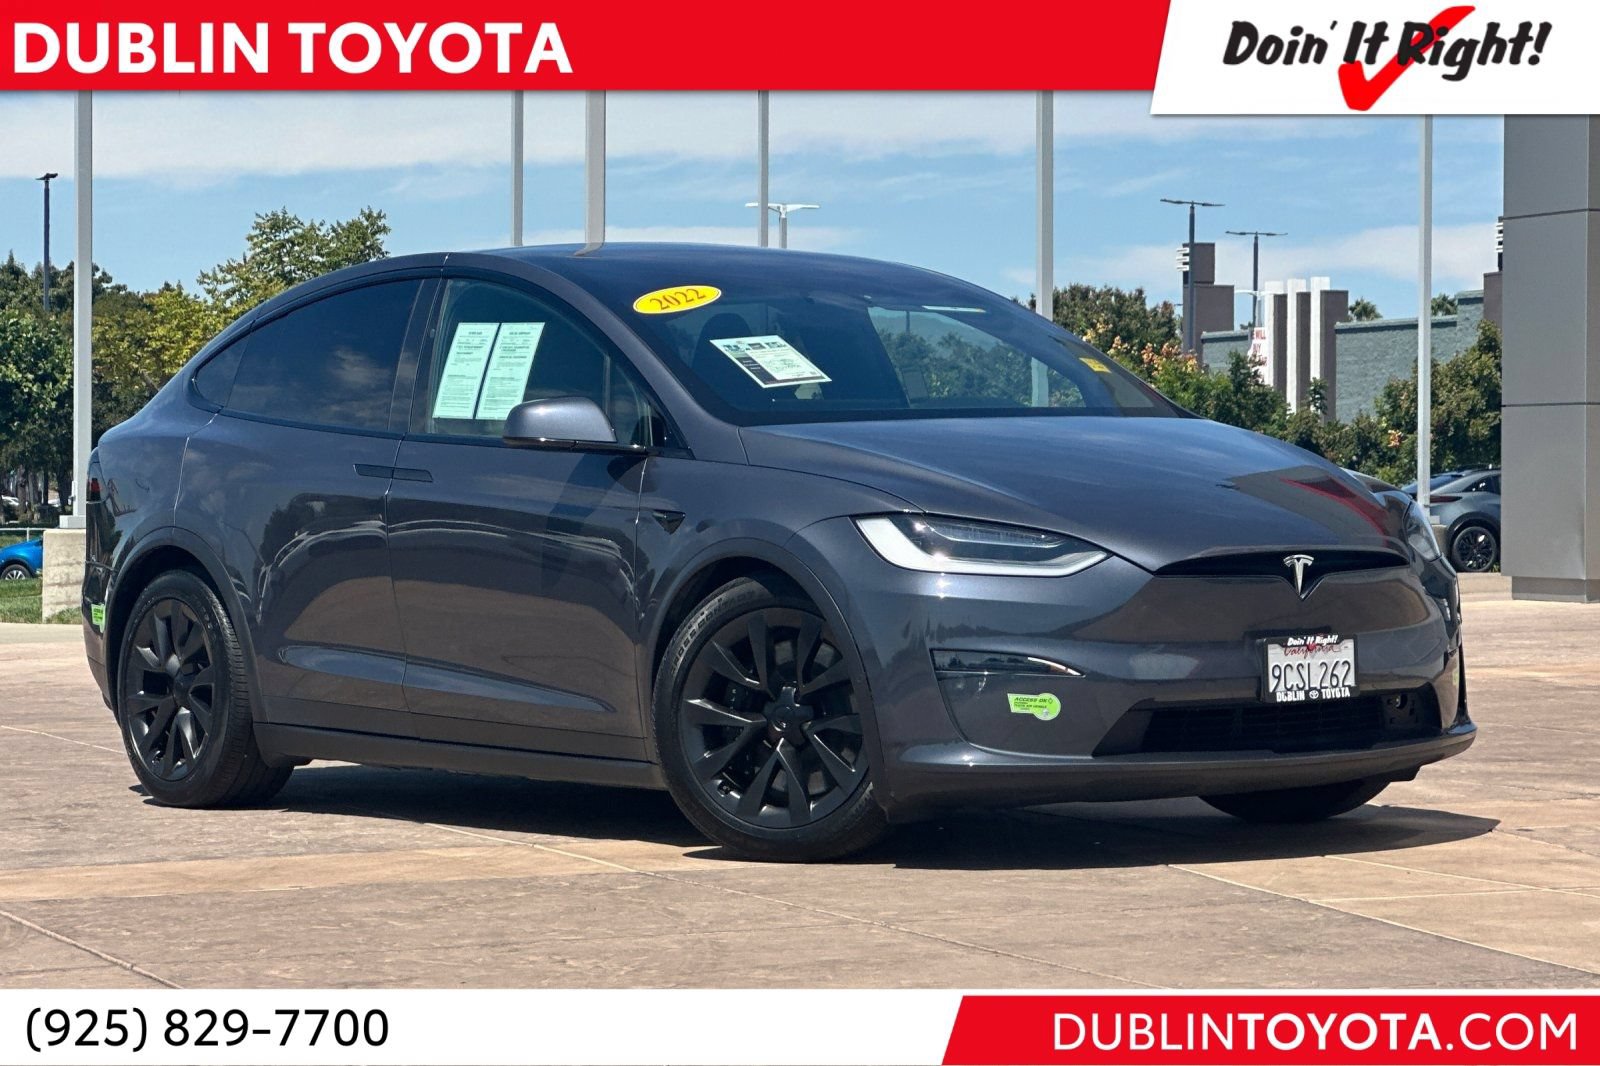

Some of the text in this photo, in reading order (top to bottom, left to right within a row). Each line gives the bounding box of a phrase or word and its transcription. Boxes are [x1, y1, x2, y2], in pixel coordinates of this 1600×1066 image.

[649, 288, 706, 310] 2022
[1306, 636, 1315, 644] It
[1315, 634, 1339, 646] Right!
[1271, 660, 1351, 692] 9CSL262
[1321, 687, 1350, 699] TOYOTA
